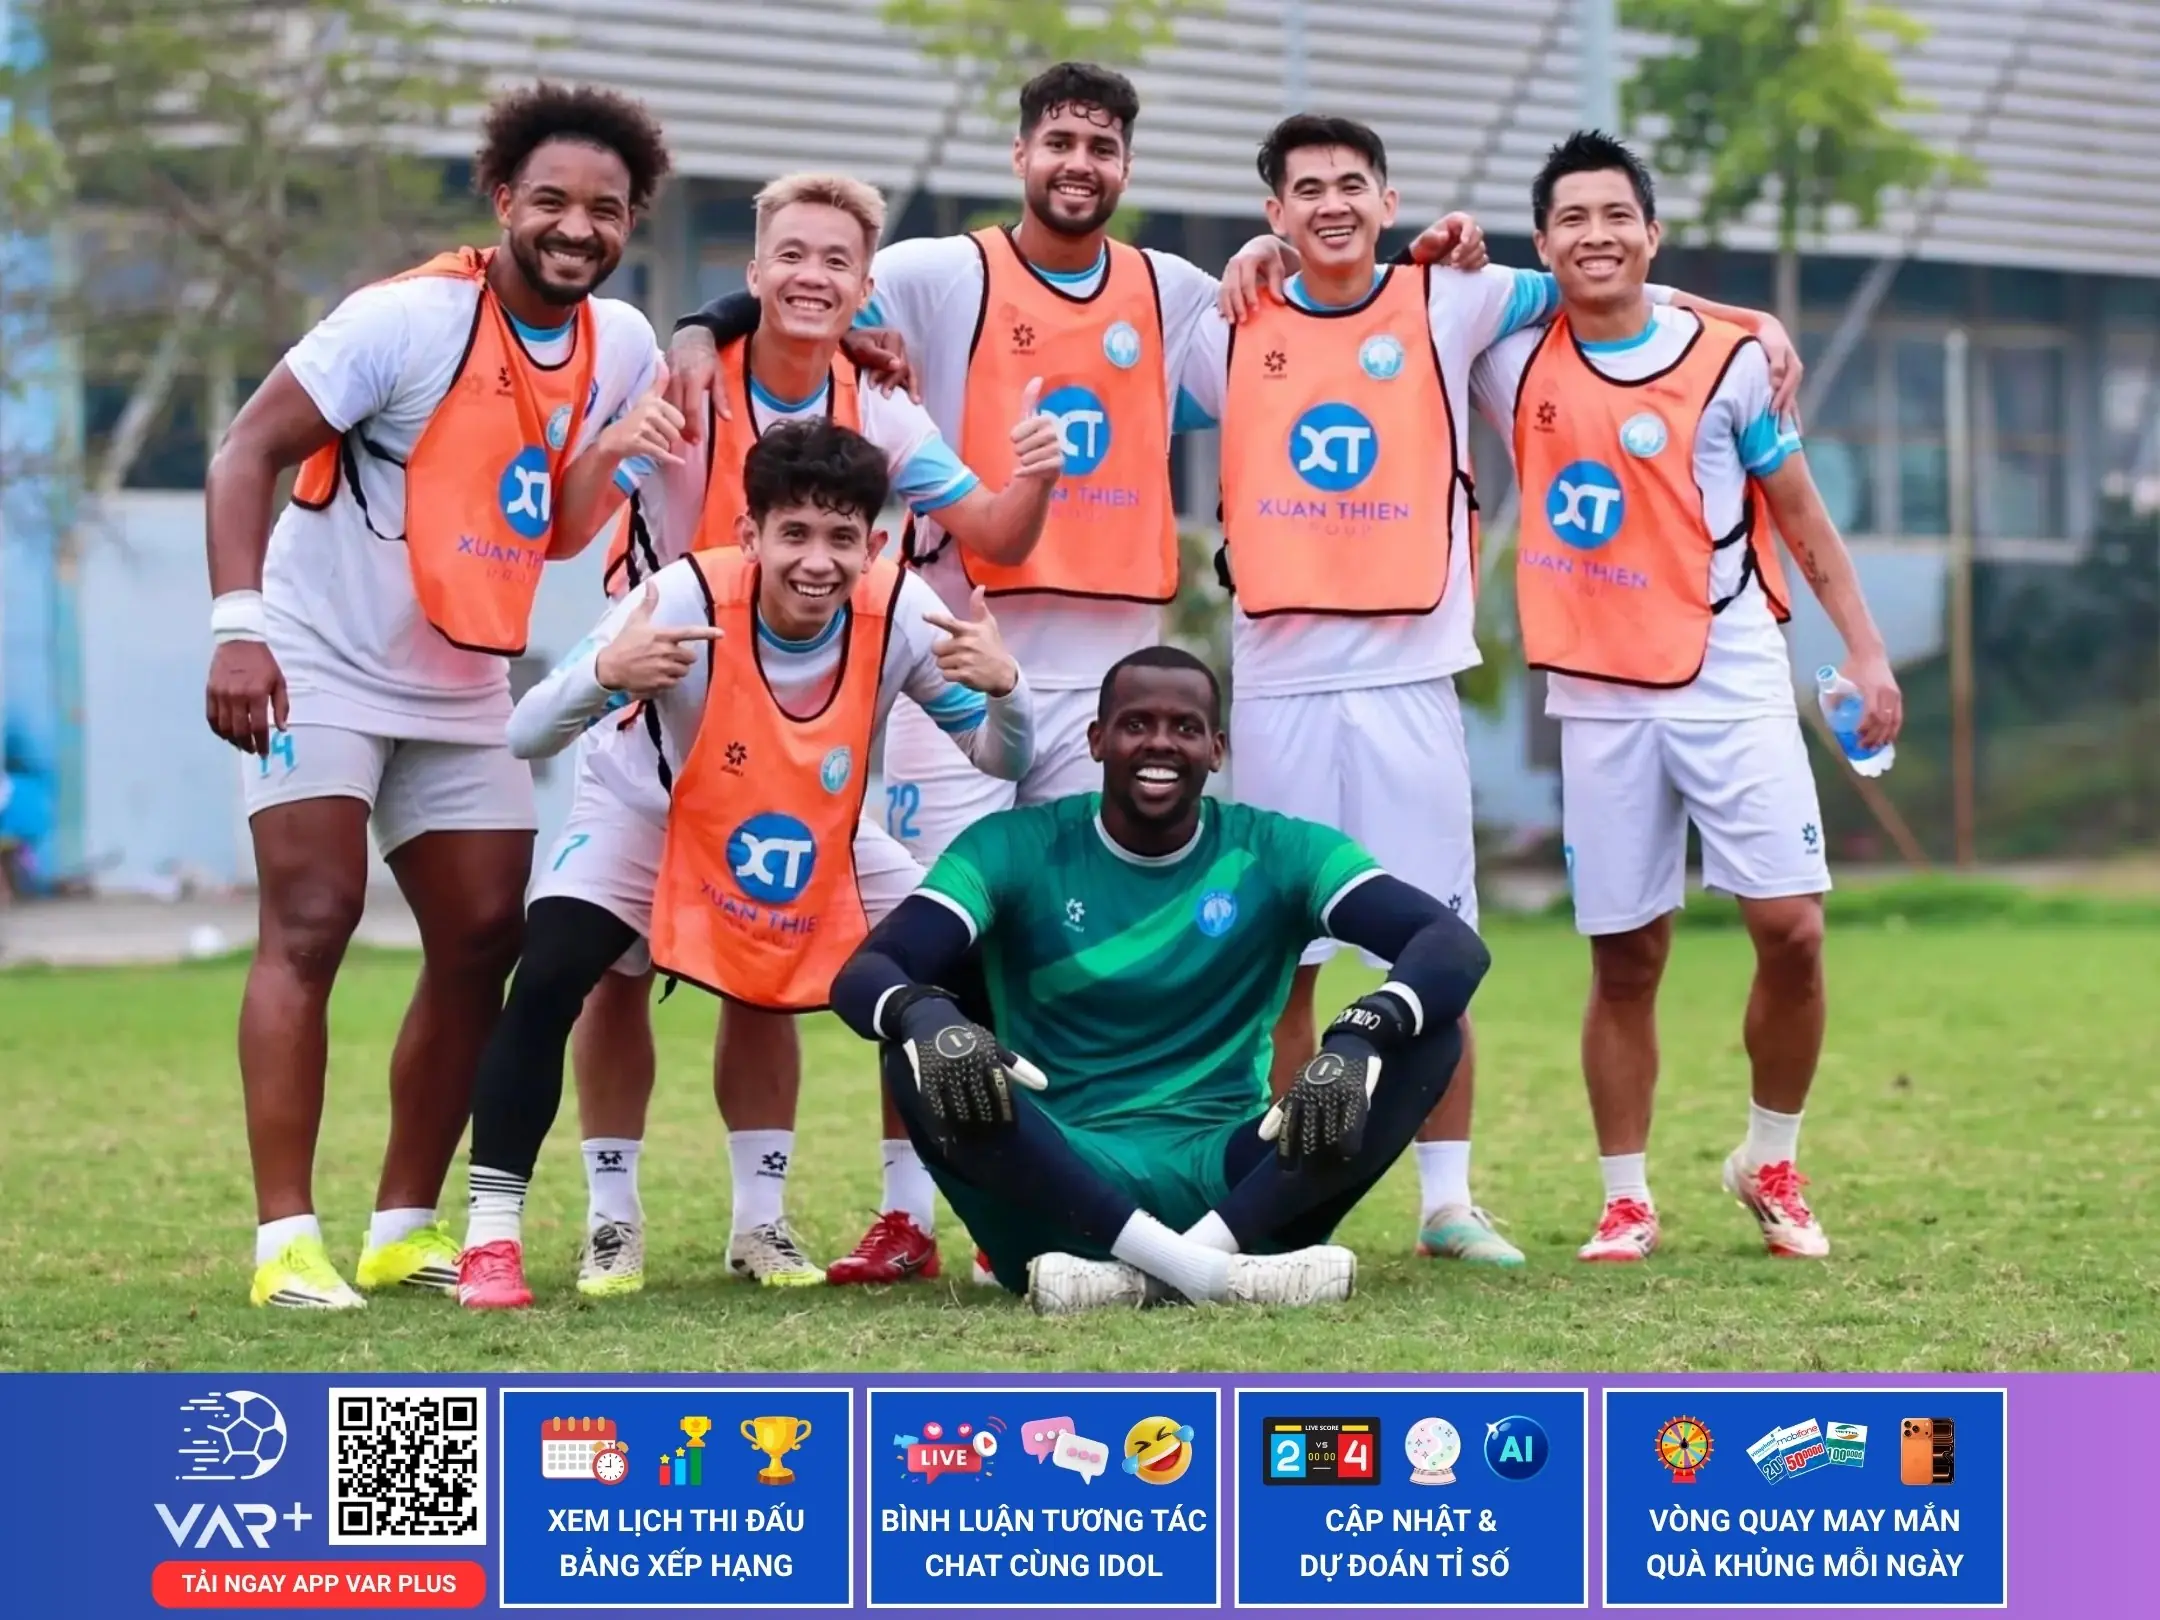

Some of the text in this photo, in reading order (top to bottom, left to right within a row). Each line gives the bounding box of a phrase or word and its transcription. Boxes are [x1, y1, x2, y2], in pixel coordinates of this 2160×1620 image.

[1299, 425, 1371, 474] XT
[1257, 498, 1409, 521] XUAN THIEN
[1553, 479, 1621, 534] XT
[457, 534, 521, 564] XUAN
[1582, 559, 1649, 589] THIEN
[735, 831, 813, 889] XT
